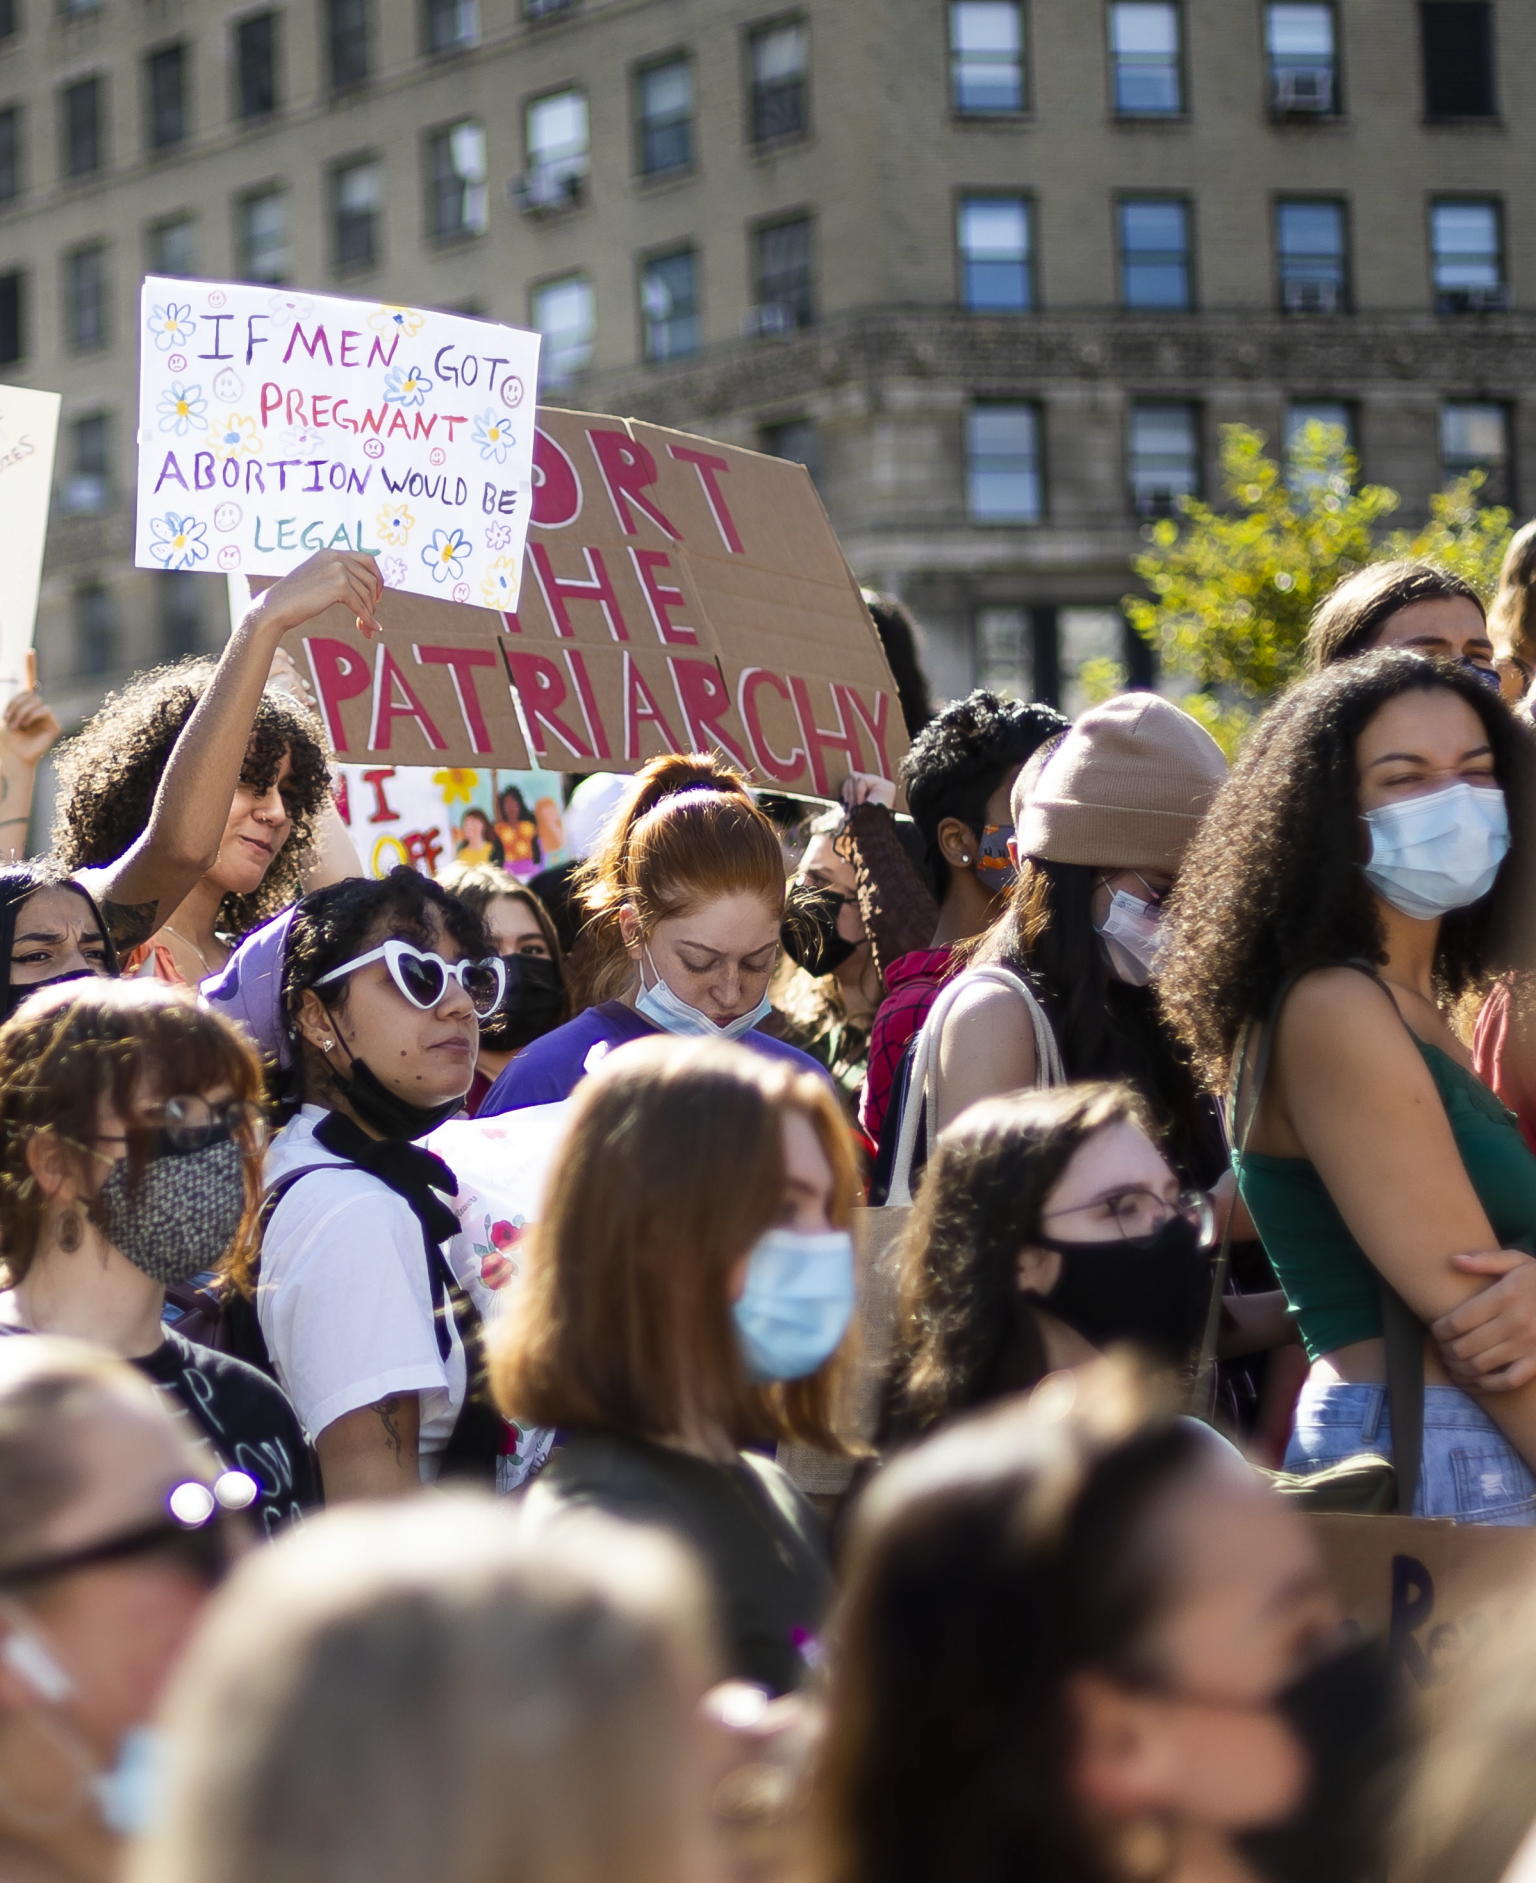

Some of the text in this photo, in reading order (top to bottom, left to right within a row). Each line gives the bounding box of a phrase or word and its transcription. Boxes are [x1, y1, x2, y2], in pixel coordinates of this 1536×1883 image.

[197, 313, 510, 391] IF MEN GOT
[259, 382, 469, 442] PREGNANT
[153, 450, 518, 515] ABORTION WOULD BE
[528, 426, 745, 554] ORT
[253, 515, 382, 557] LEGAL
[499, 541, 700, 646] HE
[302, 636, 894, 797] PATRIARCHY
